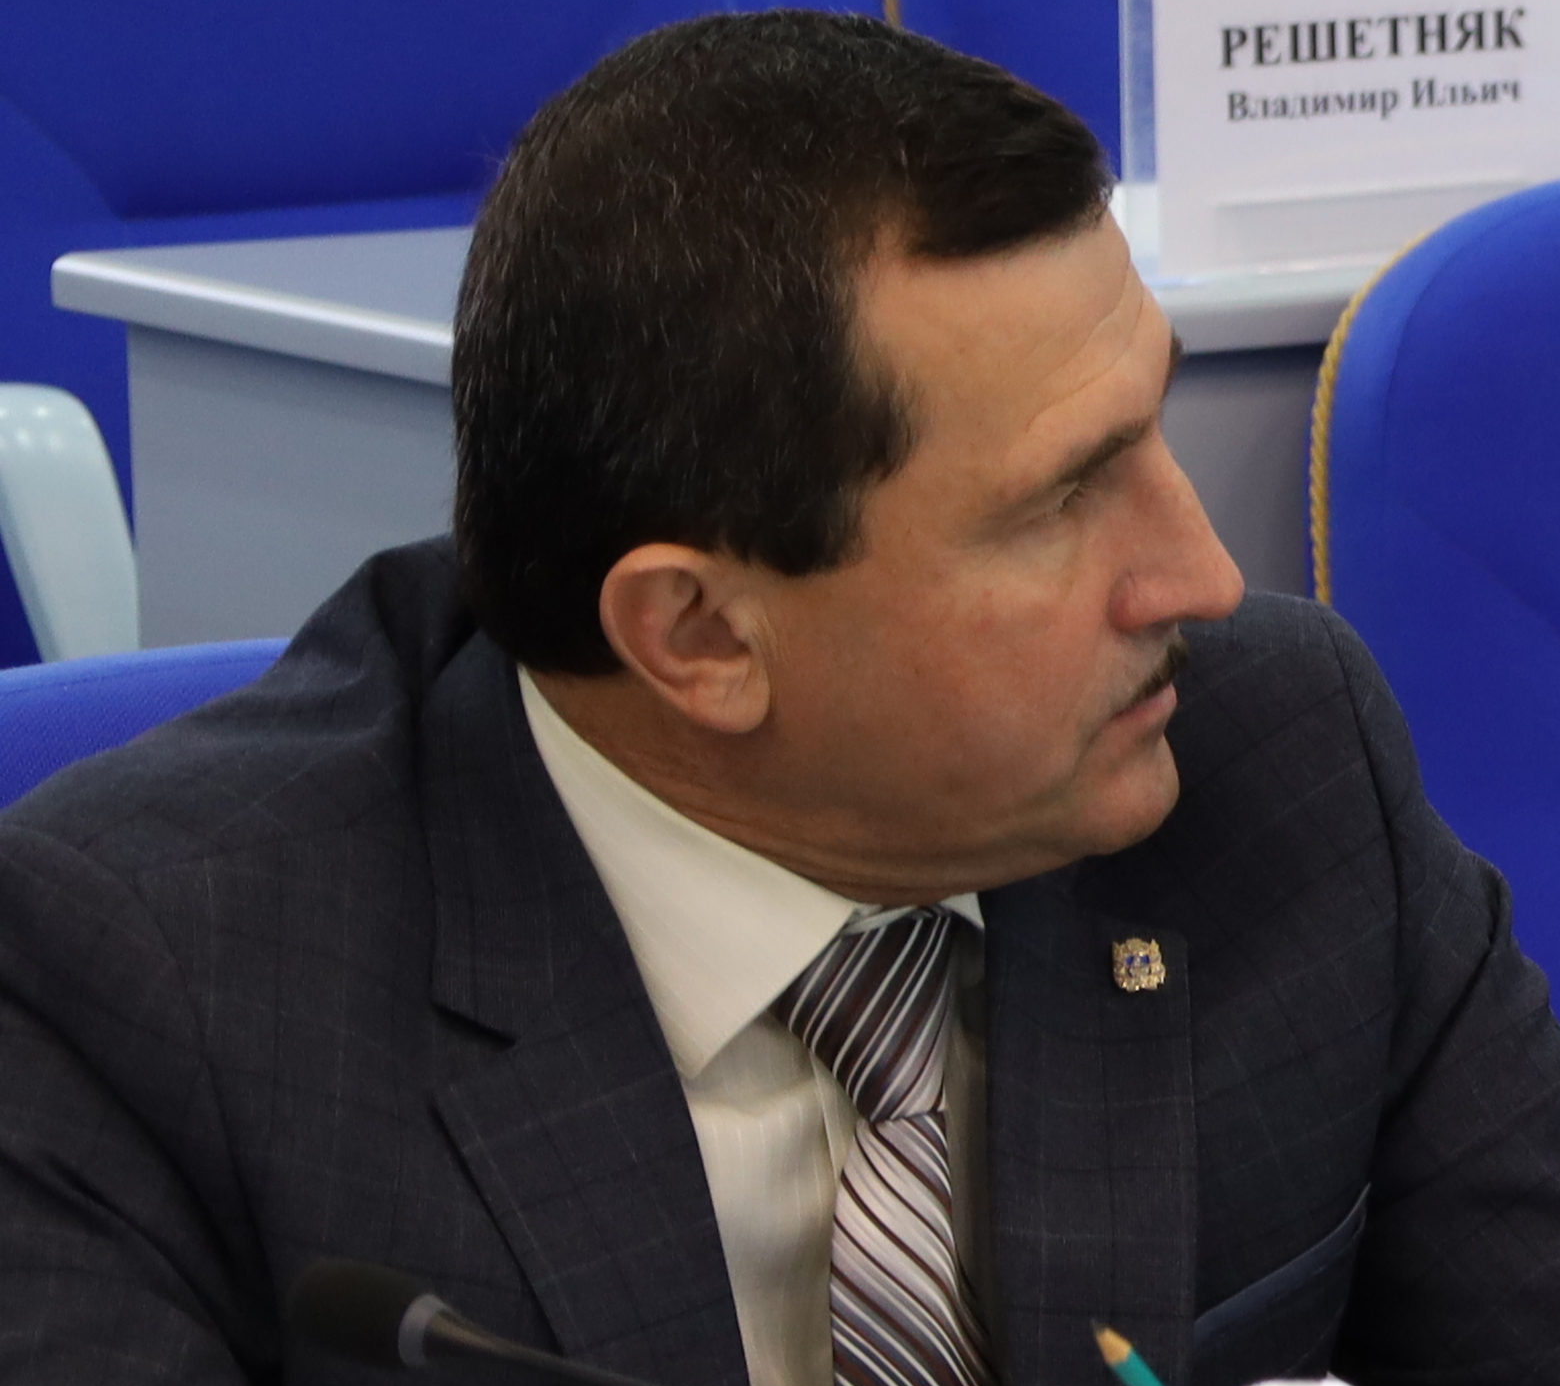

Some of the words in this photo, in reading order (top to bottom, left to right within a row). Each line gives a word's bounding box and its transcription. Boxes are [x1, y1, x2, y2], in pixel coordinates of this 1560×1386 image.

[1221, 7, 1526, 69] РЕШЕТНЯК
[1226, 88, 1401, 123] Владимир
[1410, 76, 1522, 110] Ильич
